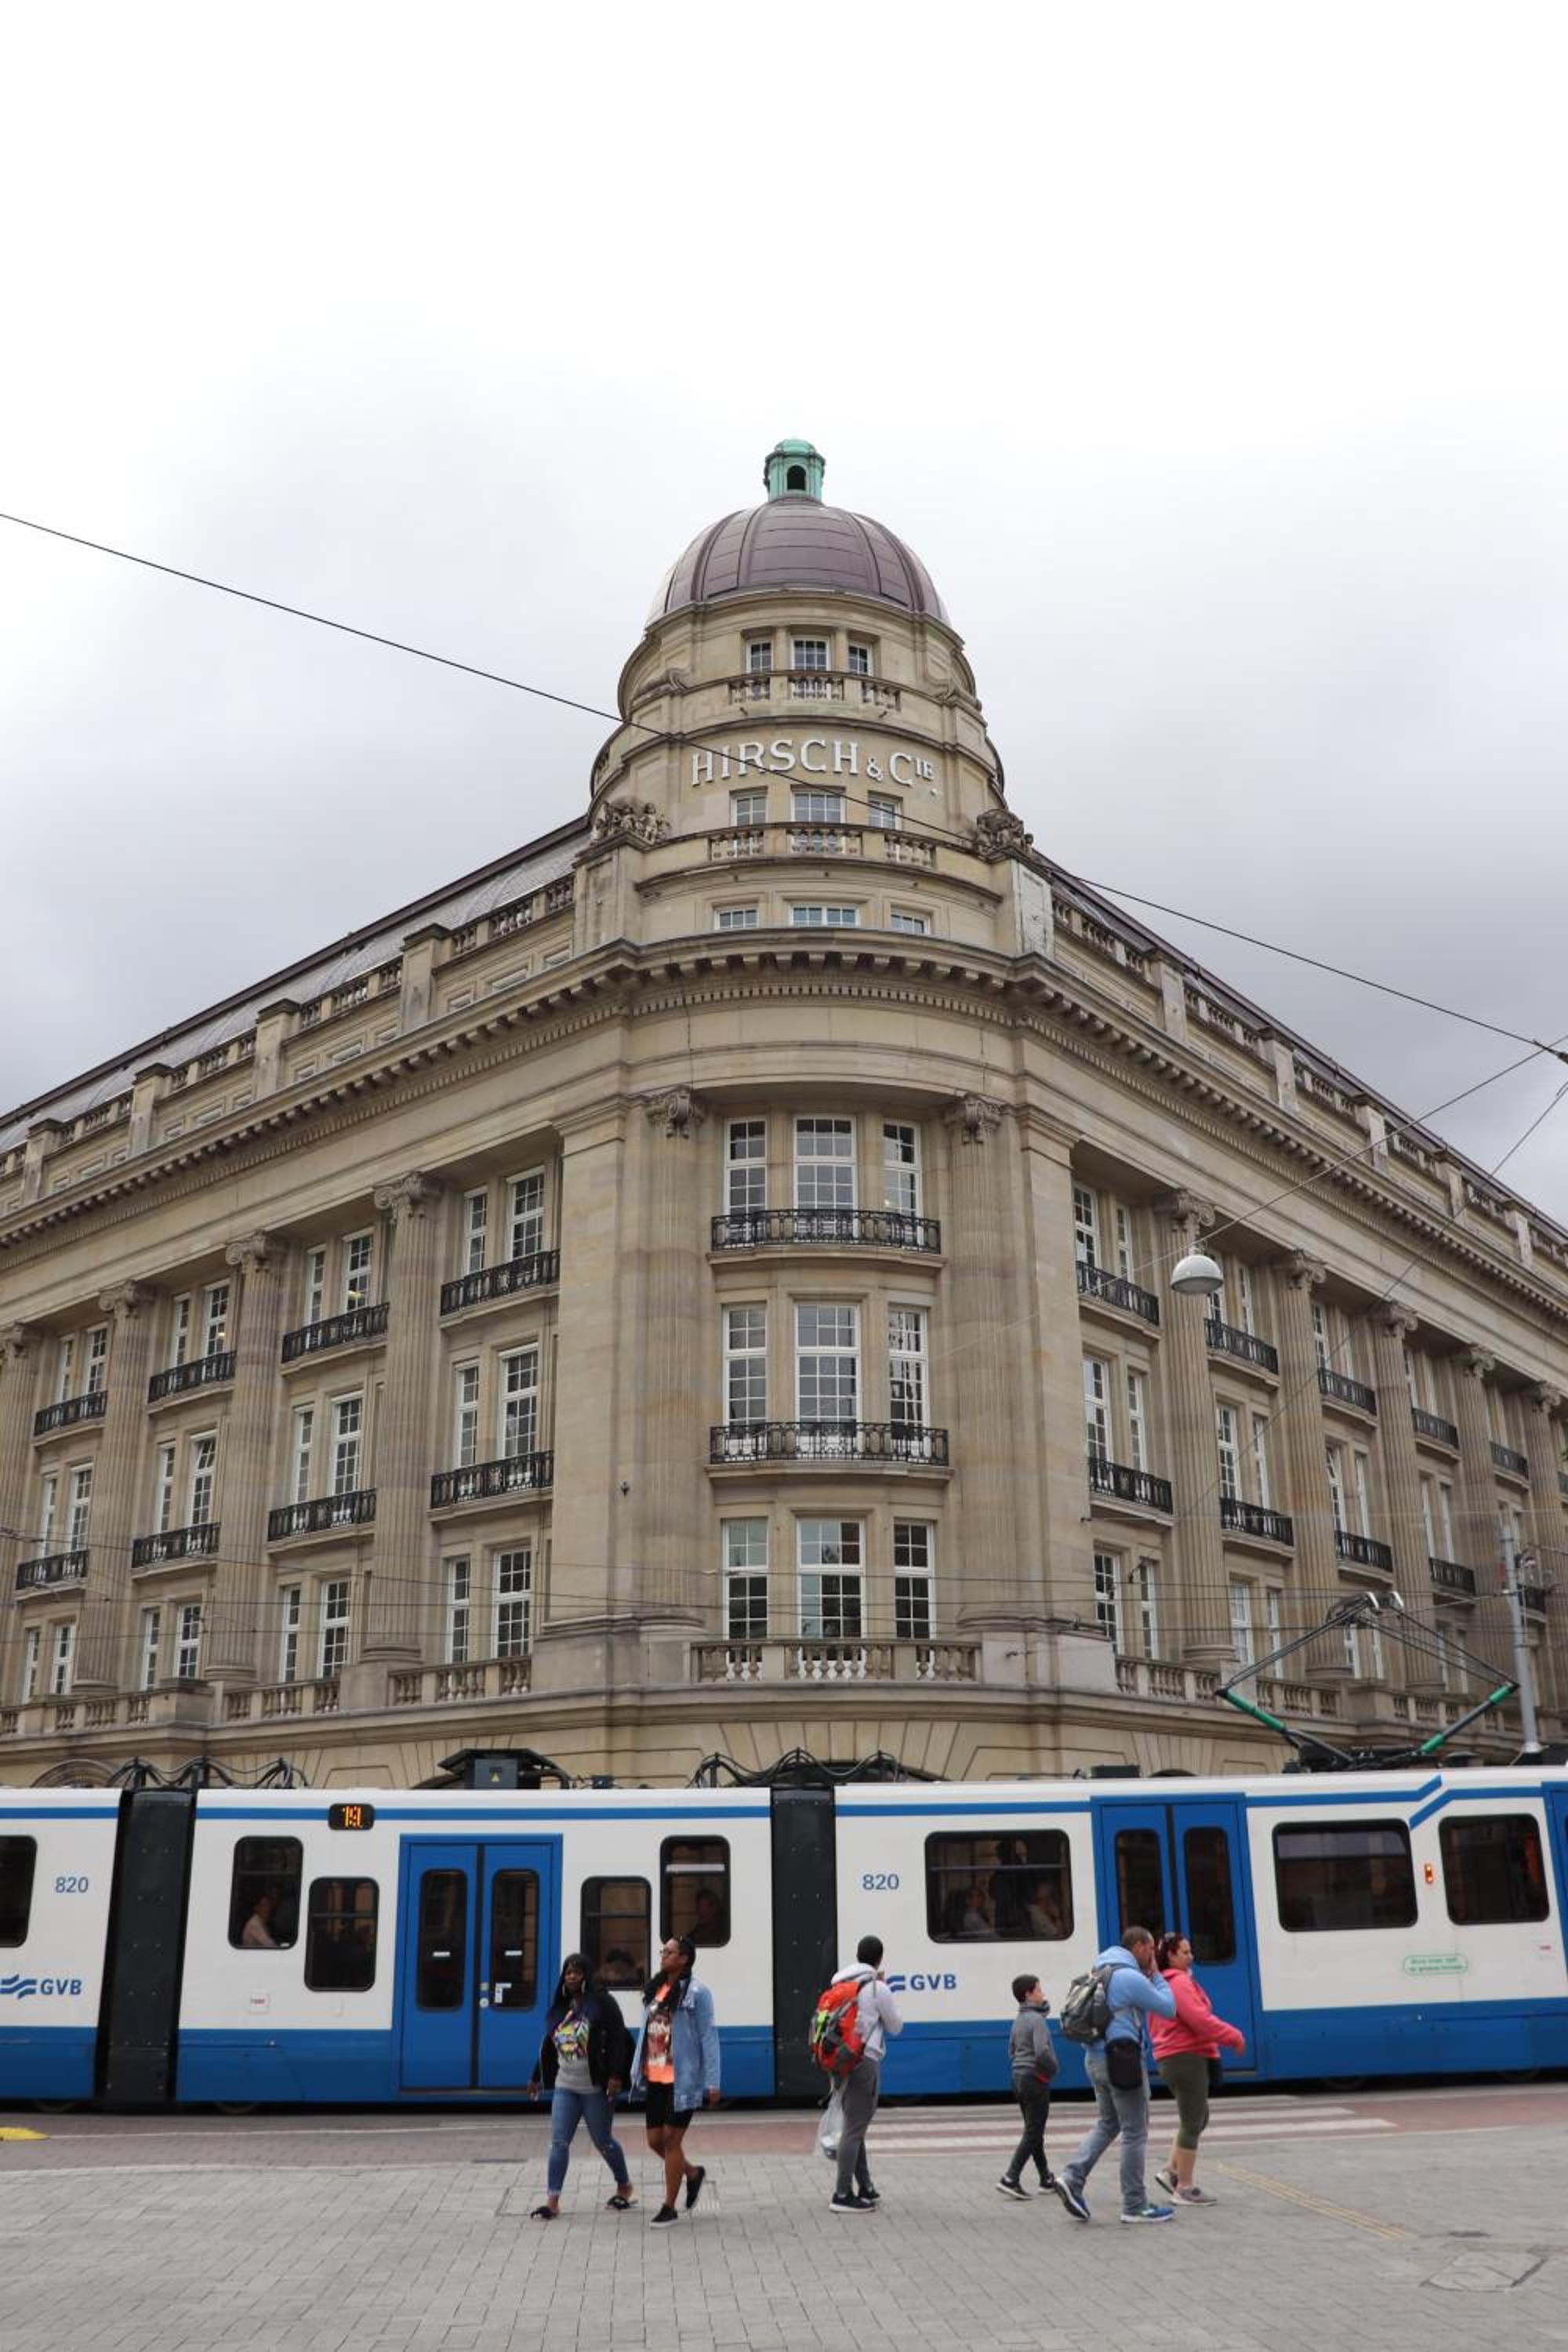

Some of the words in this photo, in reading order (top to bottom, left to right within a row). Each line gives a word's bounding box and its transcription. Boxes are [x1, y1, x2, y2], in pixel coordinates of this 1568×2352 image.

[691, 739, 858, 787] HIRSCH
[866, 757, 884, 782] &
[55, 1877, 89, 1893] 820
[862, 1874, 899, 1890] 820
[40, 1979, 82, 1995] GVB
[910, 1974, 956, 1991] GVB
